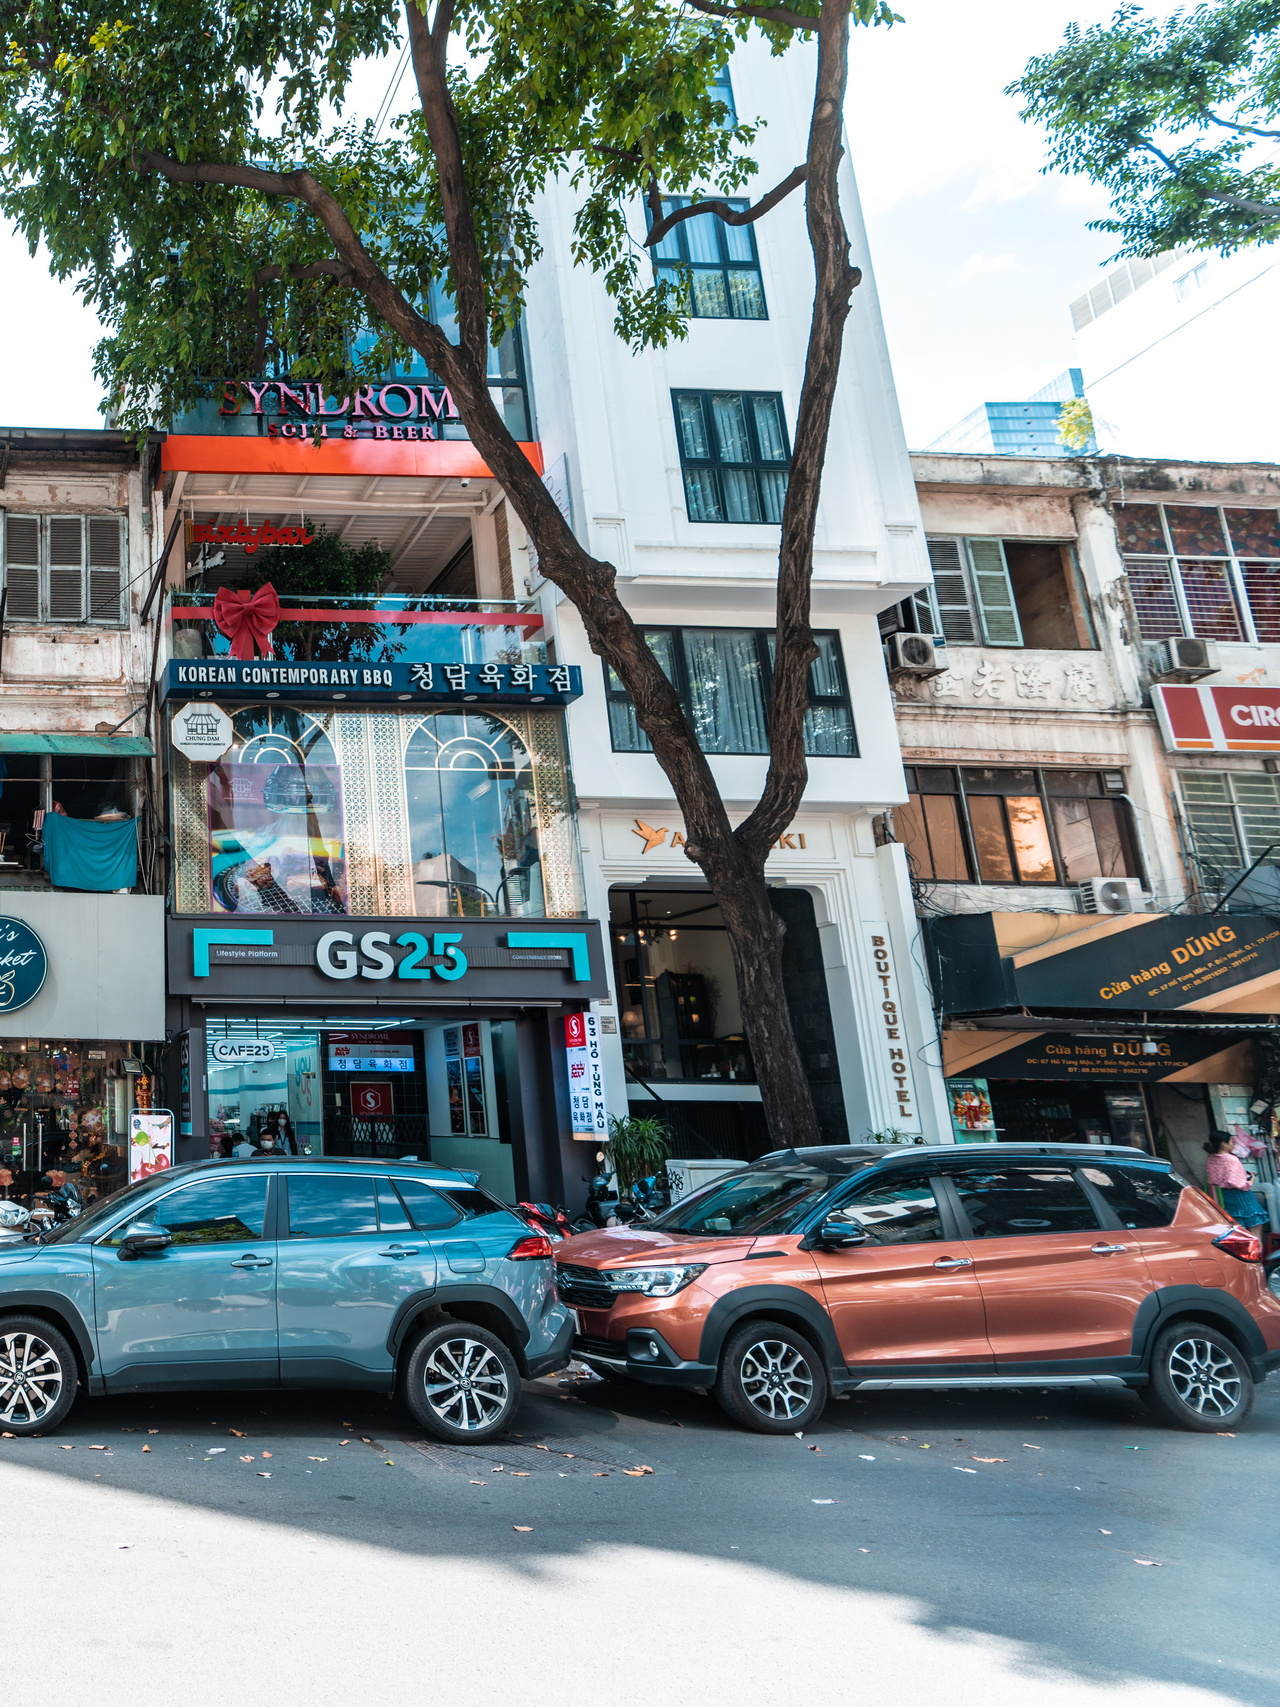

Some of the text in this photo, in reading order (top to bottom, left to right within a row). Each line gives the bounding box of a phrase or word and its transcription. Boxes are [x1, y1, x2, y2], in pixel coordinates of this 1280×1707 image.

[220, 381, 458, 418] SYNDROM
[344, 424, 358, 438] &
[375, 425, 436, 440] BEER
[193, 518, 314, 554] sixtybar
[178, 666, 393, 687] KOREAN CONTEMPORARY BBQ
[411, 662, 572, 692] 청담육화점
[1230, 704, 1280, 727] CIR
[216, 950, 246, 958] Lifestyle
[316, 930, 468, 981] GS25
[1099, 925, 1237, 1000] Cửa hàng DŨNG
[871, 935, 912, 1117] BOUTIQUE HOTEL
[218, 1045, 270, 1056] CAFE25
[1046, 1043, 1071, 1054] Cửa
[1075, 1044, 1107, 1057] hàng
[338, 1058, 408, 1070] 청담육화점
